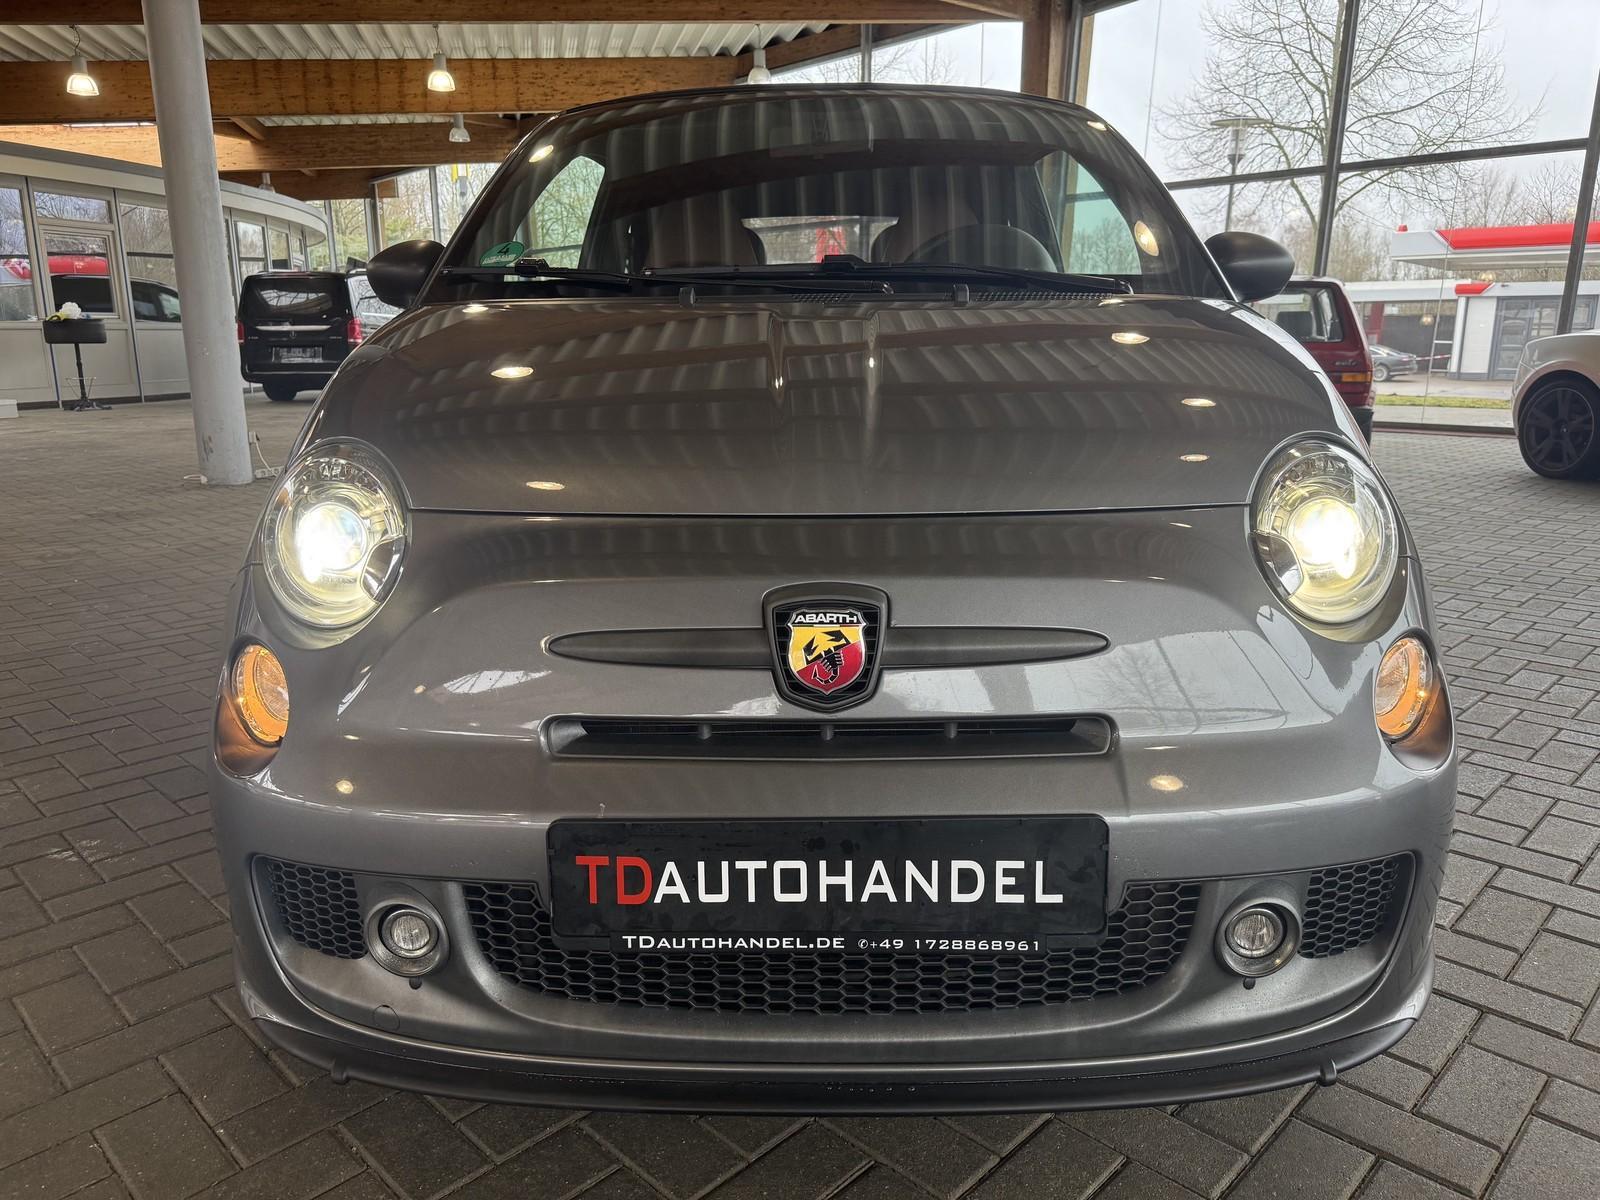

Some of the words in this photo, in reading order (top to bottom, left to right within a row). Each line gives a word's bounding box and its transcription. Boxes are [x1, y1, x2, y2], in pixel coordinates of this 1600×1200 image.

[497, 242, 511, 255] 4
[795, 613, 858, 624] ABARTH
[575, 855, 1064, 905] TDAUTOHANDEL
[622, 935, 845, 949] TDAUTOHANDEL.DE
[914, 938, 1040, 951] 1728868961
